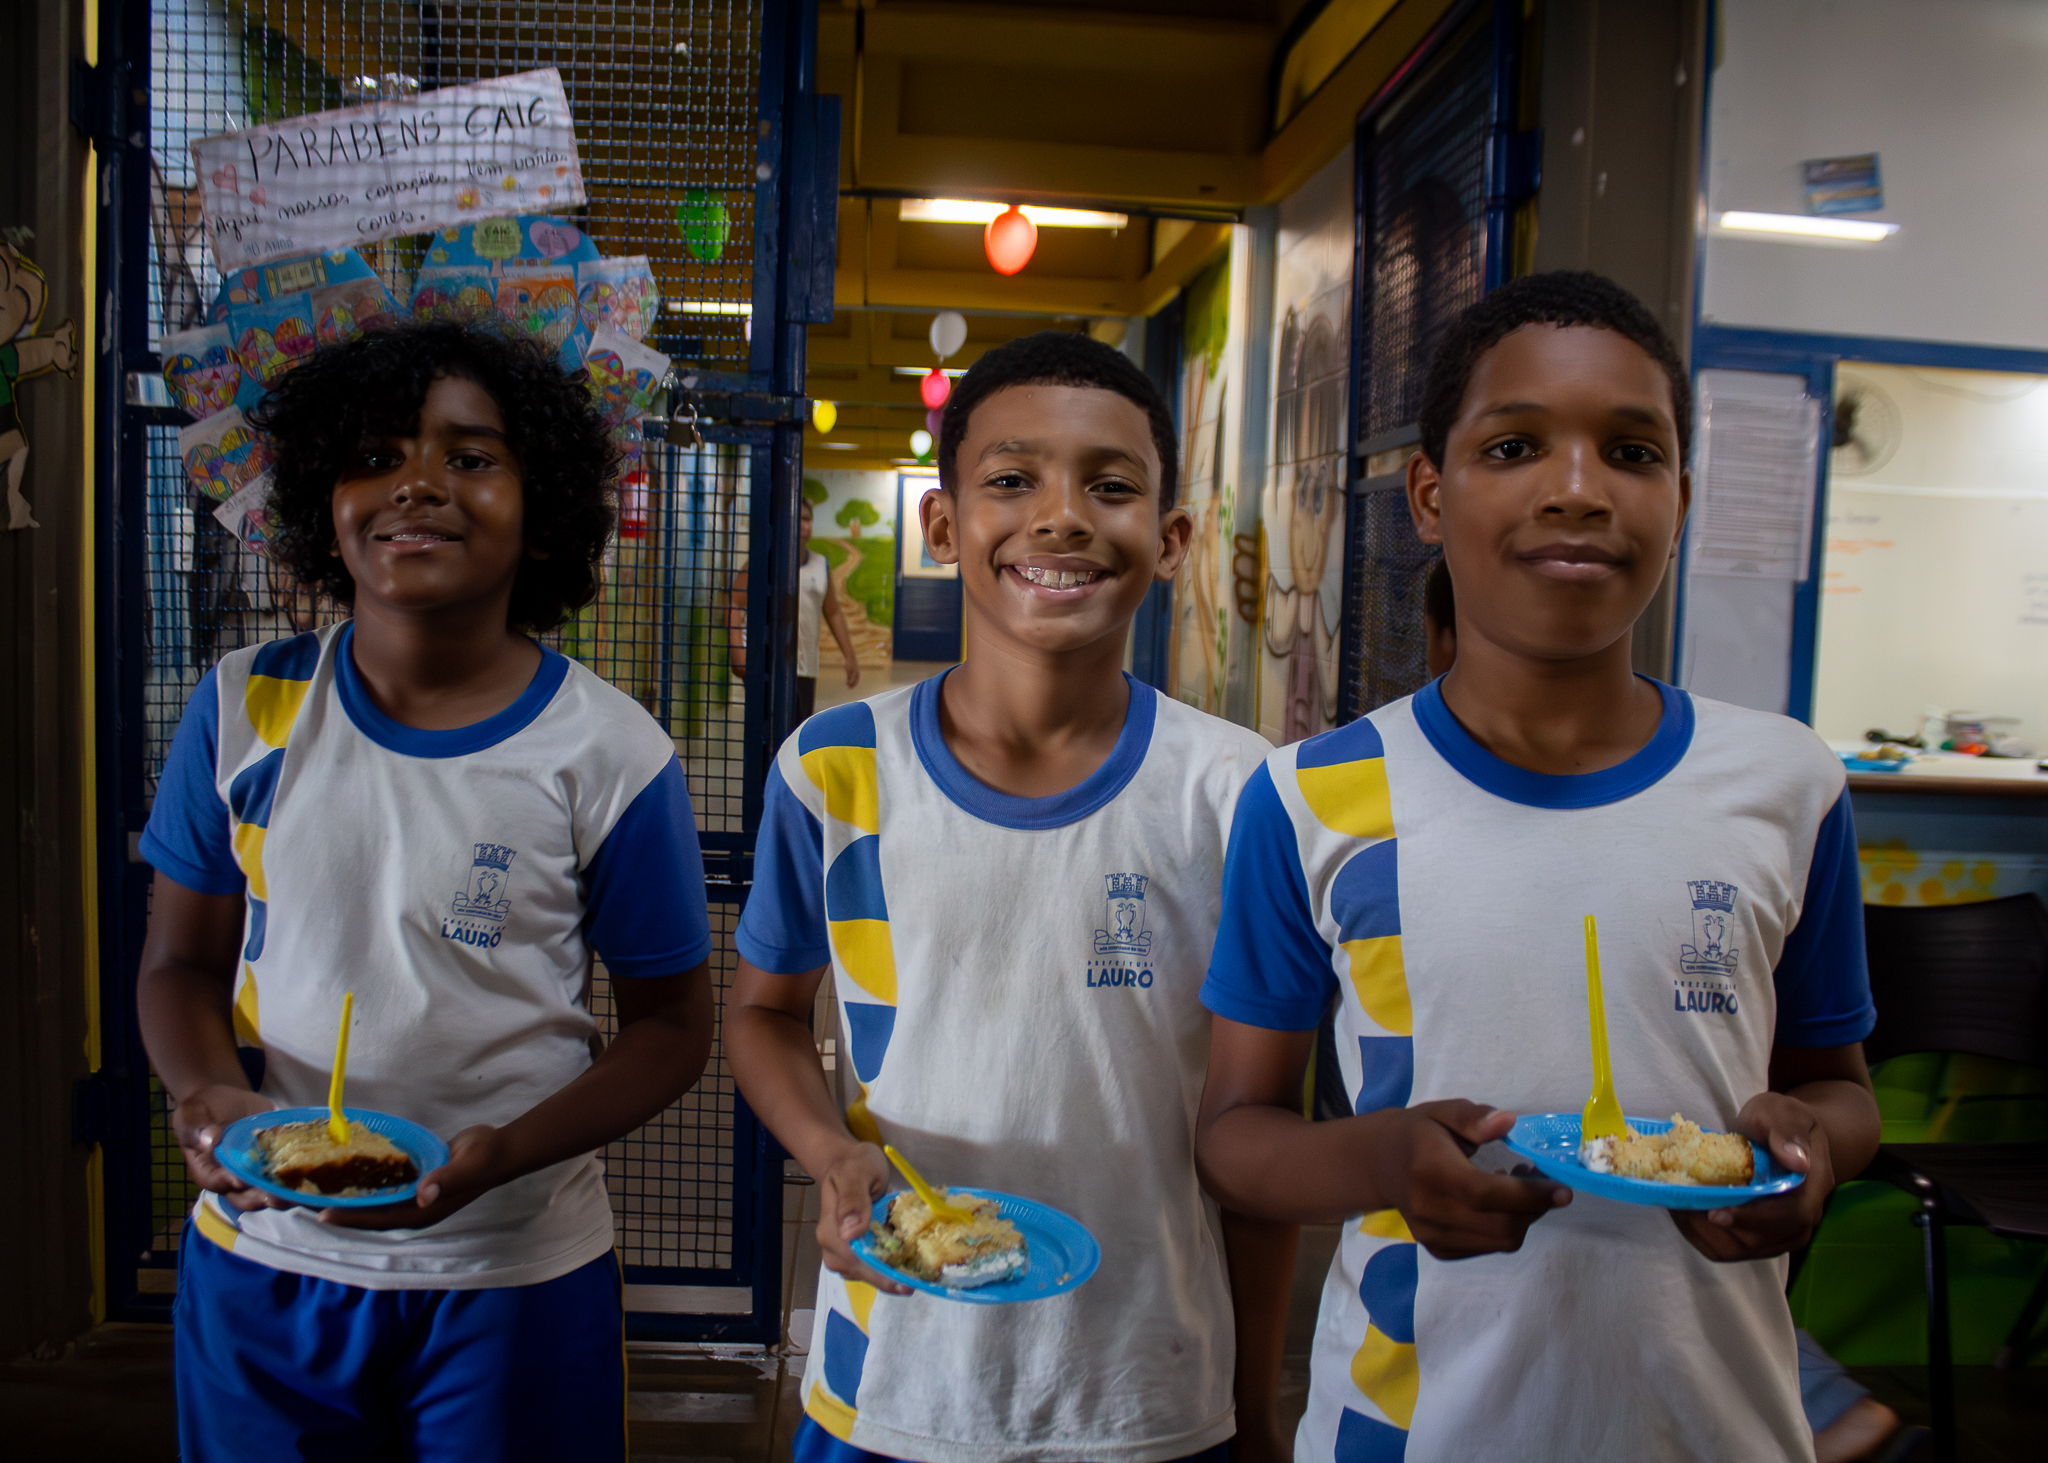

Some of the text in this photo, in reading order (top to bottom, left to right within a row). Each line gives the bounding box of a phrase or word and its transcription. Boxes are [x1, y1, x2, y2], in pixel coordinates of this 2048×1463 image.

[464, 97, 547, 137] CAIC
[215, 208, 263, 242] Aqui
[278, 192, 350, 220] nossos
[441, 923, 502, 949] LAURO
[1086, 967, 1154, 989] LAURO
[1674, 988, 1739, 1015] LAURO
